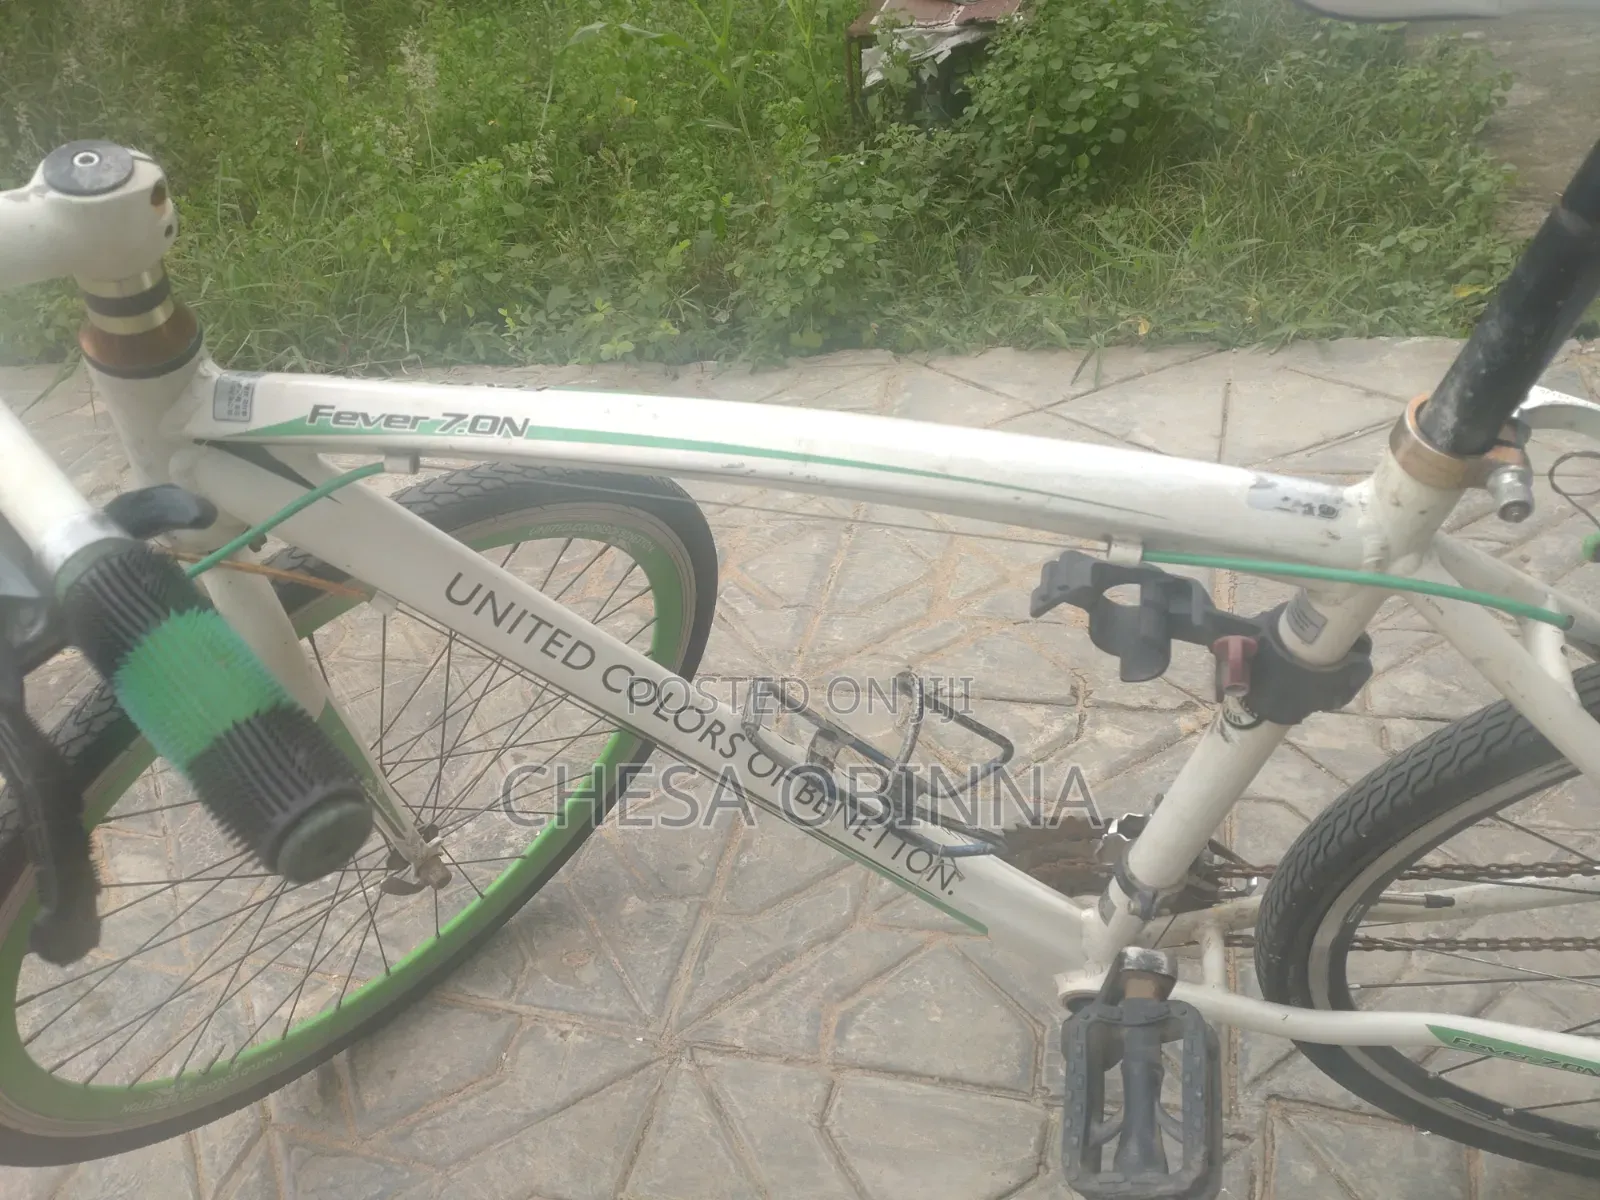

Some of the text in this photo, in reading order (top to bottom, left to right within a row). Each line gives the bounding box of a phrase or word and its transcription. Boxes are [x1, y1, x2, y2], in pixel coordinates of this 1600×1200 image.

[305, 403, 431, 431] Fever
[444, 571, 597, 671] UNITED
[601, 663, 747, 759] COLORS
